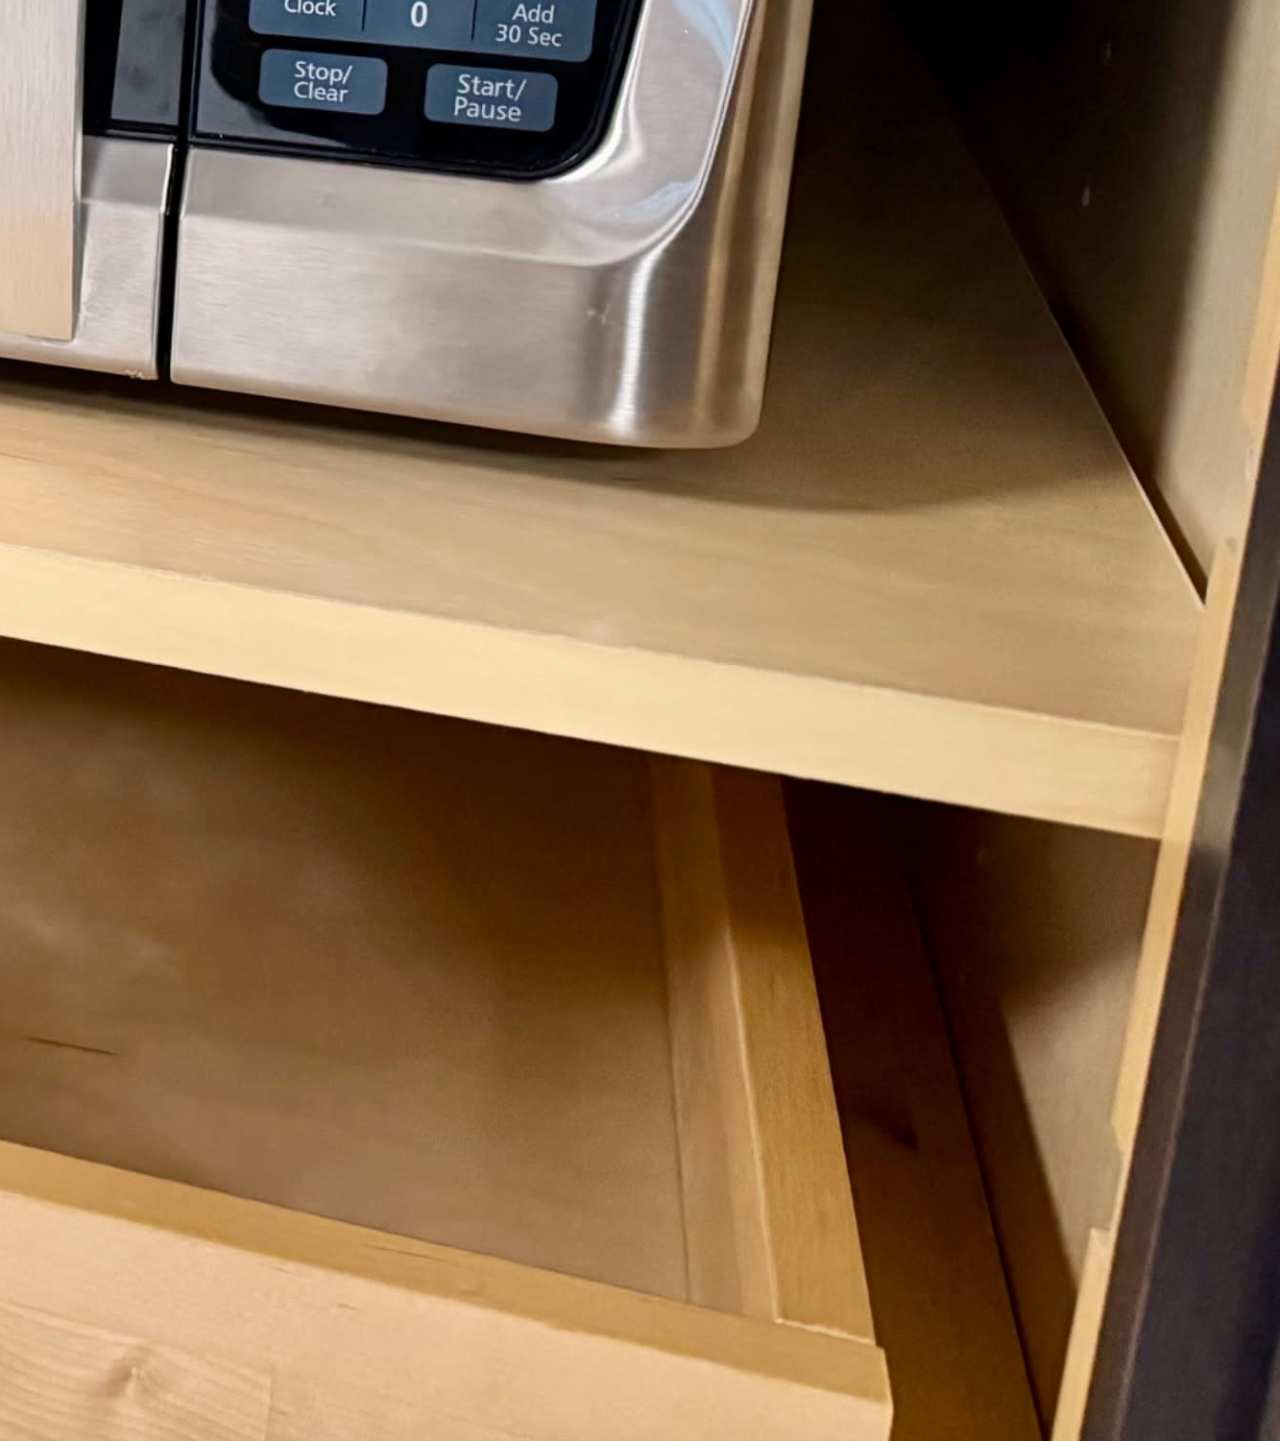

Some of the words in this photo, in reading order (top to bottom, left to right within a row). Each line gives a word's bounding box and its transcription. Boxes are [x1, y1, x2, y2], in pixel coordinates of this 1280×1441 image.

[410, 0, 429, 28] 0
[512, 3, 555, 24] Add
[495, 25, 522, 45] 30
[526, 27, 563, 48] Sec
[294, 60, 353, 85] Stop/
[293, 81, 349, 103] Clear
[457, 74, 527, 101] Start/
[453, 96, 522, 122] Pause
